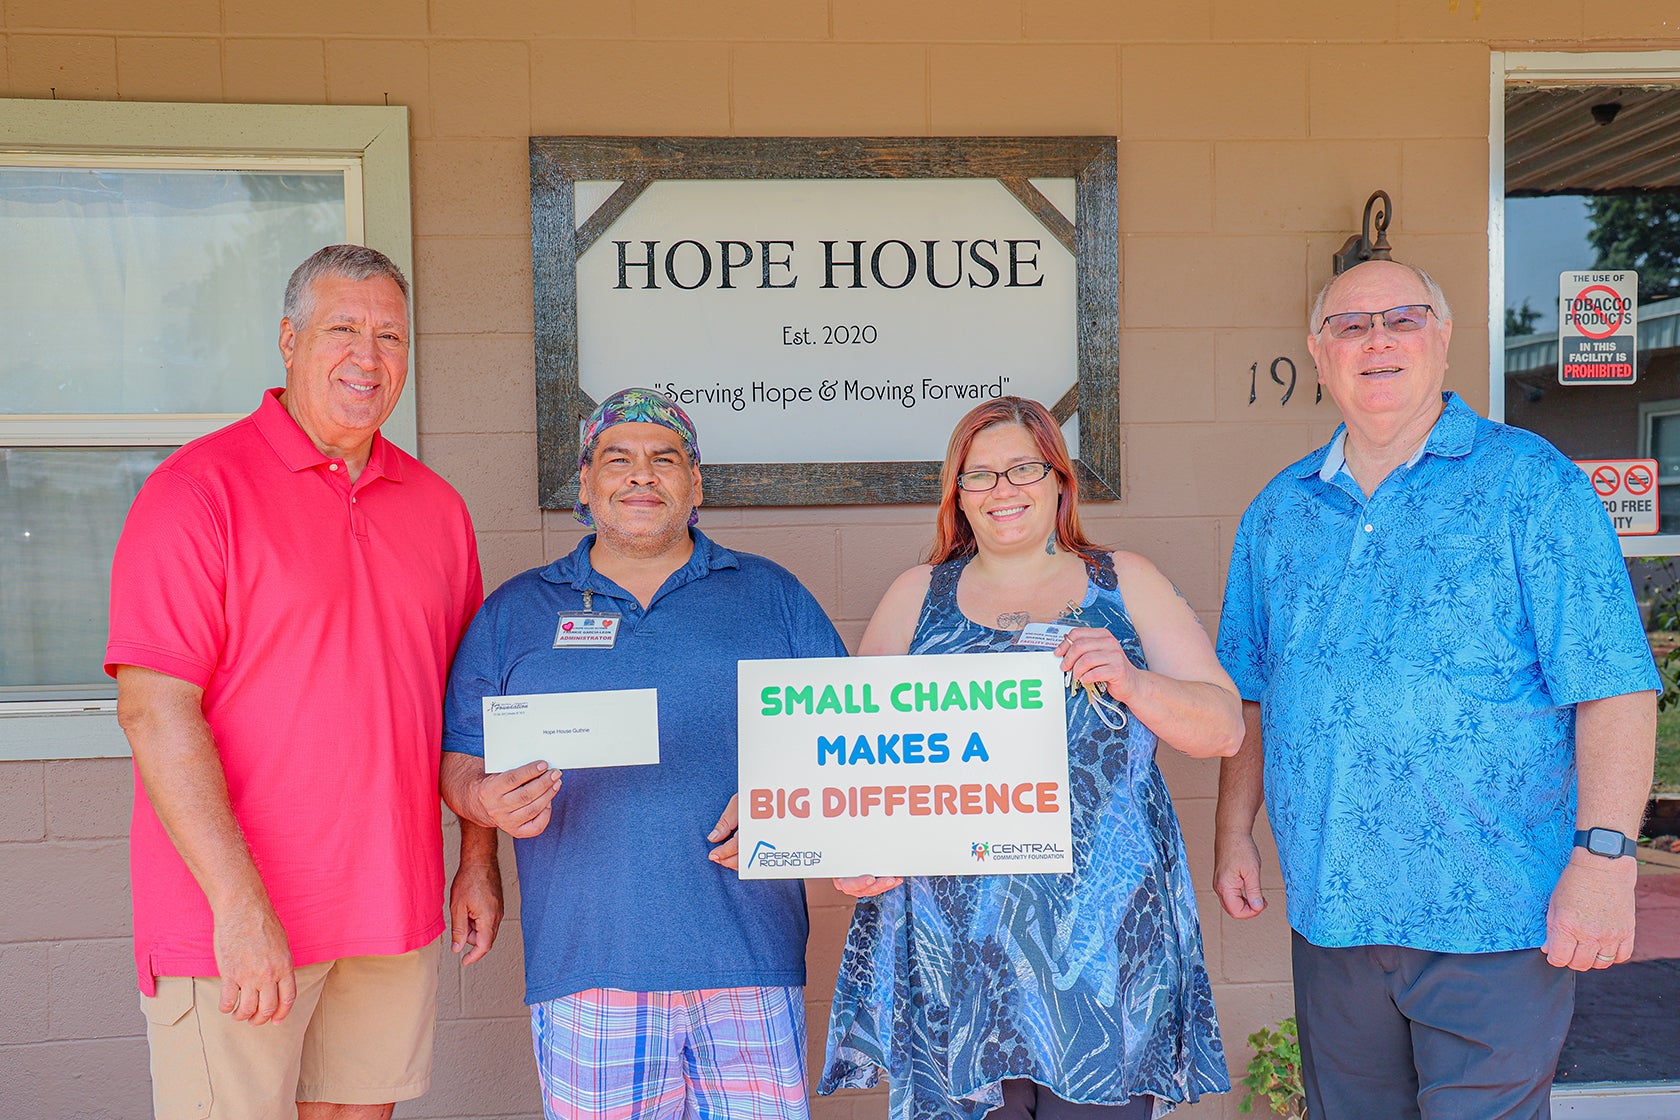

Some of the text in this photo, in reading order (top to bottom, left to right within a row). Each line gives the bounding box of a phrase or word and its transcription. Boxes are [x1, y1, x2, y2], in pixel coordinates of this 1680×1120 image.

[612, 239, 1045, 289] HOPE HOUSE
[1592, 274, 1610, 282] USE
[1612, 274, 1625, 282] OF
[1565, 297, 1632, 312] TOBACCO
[1565, 313, 1632, 325] PRODUCTS
[783, 325, 878, 345] Est. 2020
[1579, 342, 1617, 352] IN THIS
[1569, 352, 1627, 363] FACILITY IS
[1564, 364, 1632, 378] PROHIBITED
[752, 381, 813, 410] Hope
[818, 379, 839, 402] &
[844, 379, 916, 408] Moving
[922, 375, 1010, 399] Forward"
[1621, 500, 1652, 512] FREE
[761, 679, 1043, 716] SMALL CHANGE
[817, 732, 989, 766] MAKES A
[750, 782, 1059, 819] BIG DIFFERENCE
[758, 851, 822, 859] OPERATION
[991, 843, 1064, 854] CENTRAL
[760, 858, 821, 867] ROUND UP
